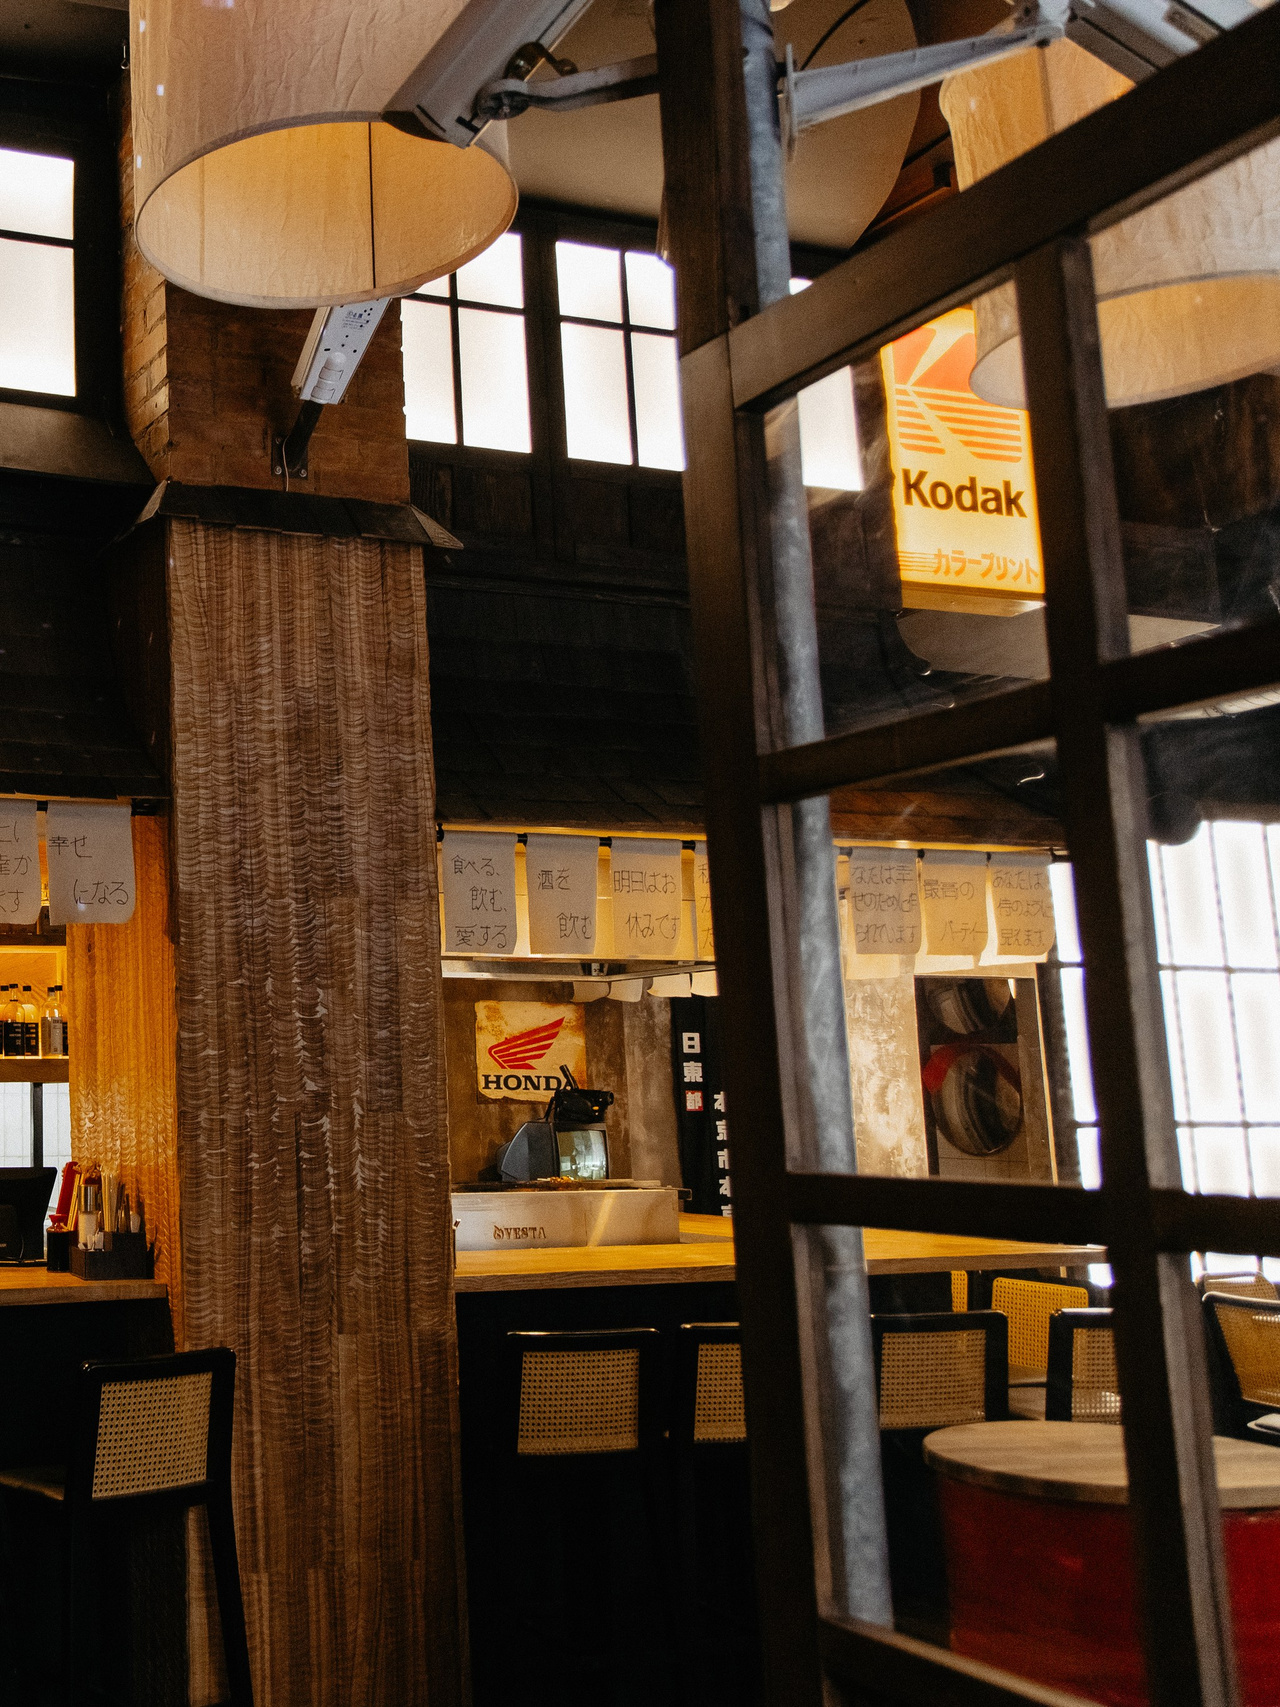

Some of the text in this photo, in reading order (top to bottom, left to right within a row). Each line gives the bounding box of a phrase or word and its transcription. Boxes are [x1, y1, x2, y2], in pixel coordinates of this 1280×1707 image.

[901, 468, 1028, 518] Kodak
[933, 548, 1039, 584] カラープリント
[49, 835, 92, 858] 幸せ
[537, 868, 570, 891] 酒を
[613, 870, 676, 893] 明日はお
[923, 880, 974, 900] 最高の
[73, 879, 129, 905] になる
[455, 924, 507, 948] 愛する
[557, 912, 592, 940] 飲む
[625, 912, 680, 939] 休みです
[504, 1226, 547, 1239] VESTA
